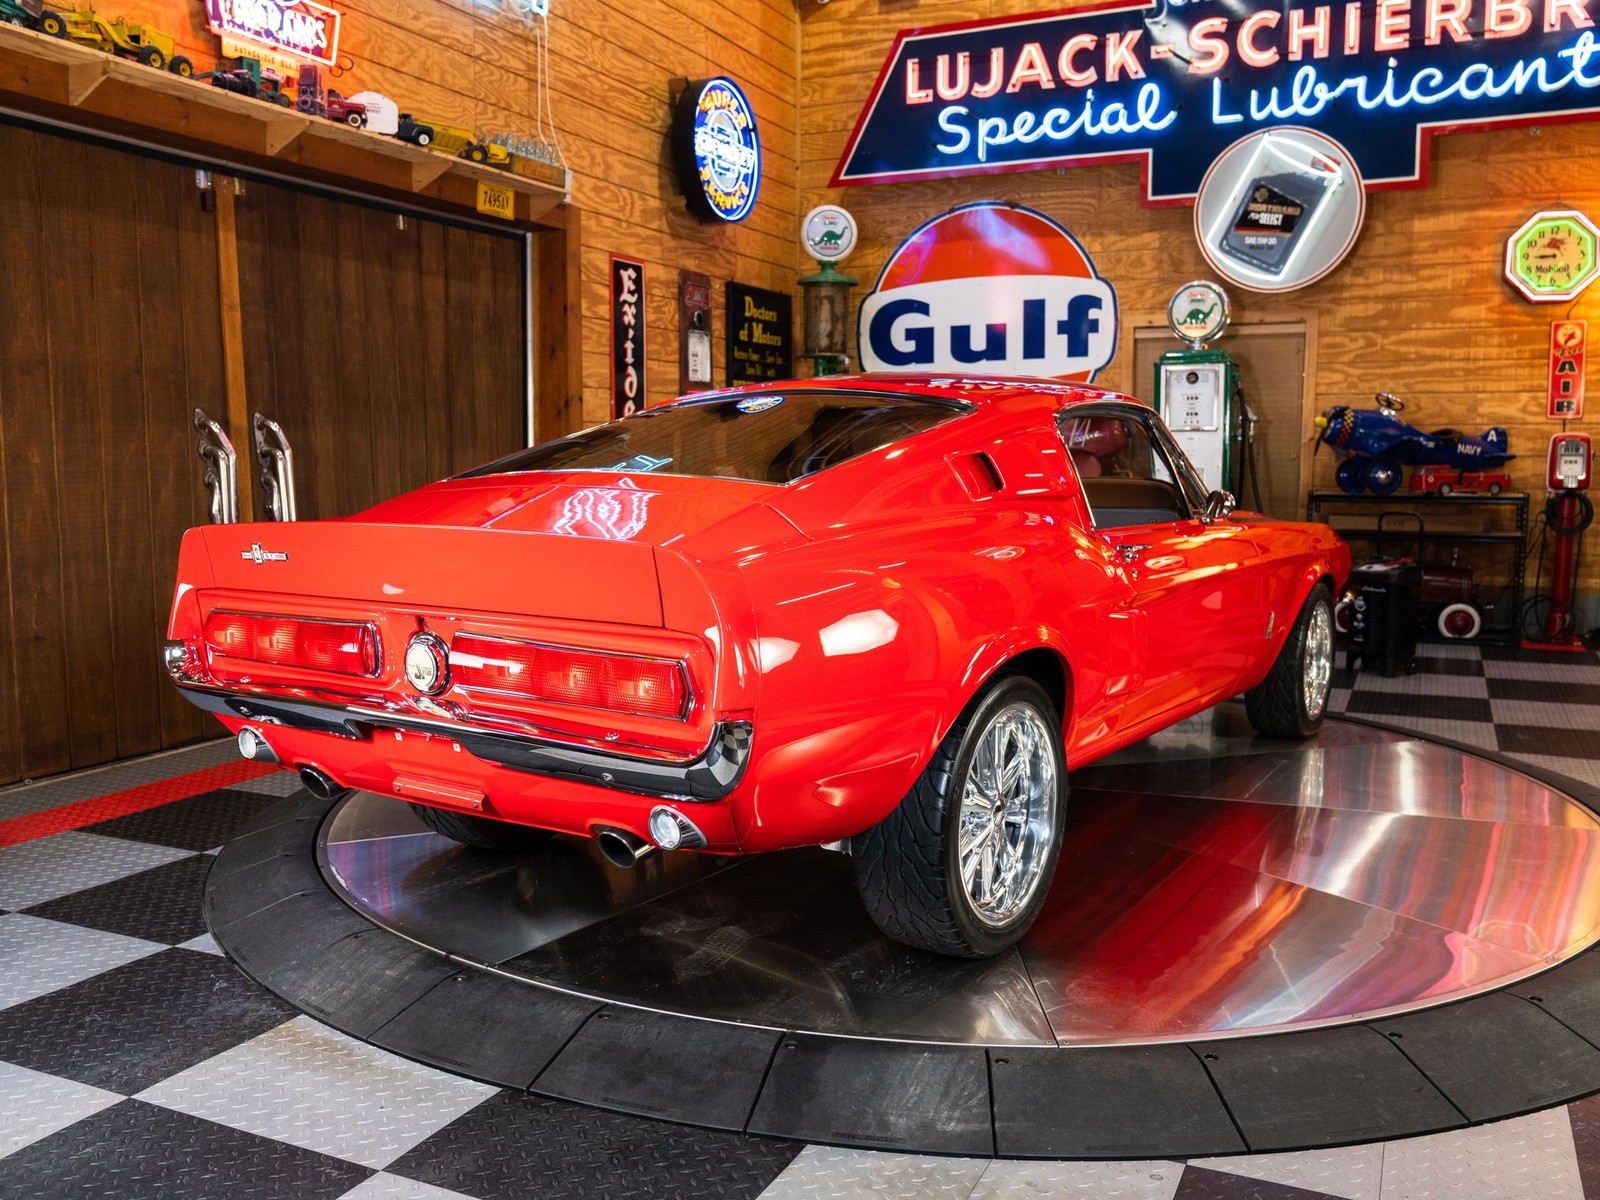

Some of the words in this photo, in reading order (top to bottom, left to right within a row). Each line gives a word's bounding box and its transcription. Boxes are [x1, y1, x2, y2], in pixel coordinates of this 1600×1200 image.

[936, 82, 1179, 161] Special
[1212, 31, 1600, 125] Lubricant
[1259, 212, 1283, 225] SELECT
[1535, 264, 1570, 273] Moboil
[744, 296, 777, 321] Doctors
[739, 323, 748, 341] of
[752, 322, 781, 345] Motors
[869, 294, 1103, 366] Gulf
[1555, 359, 1578, 414] AIR
[1487, 430, 1497, 442] A
[1457, 443, 1482, 457] NAVY
